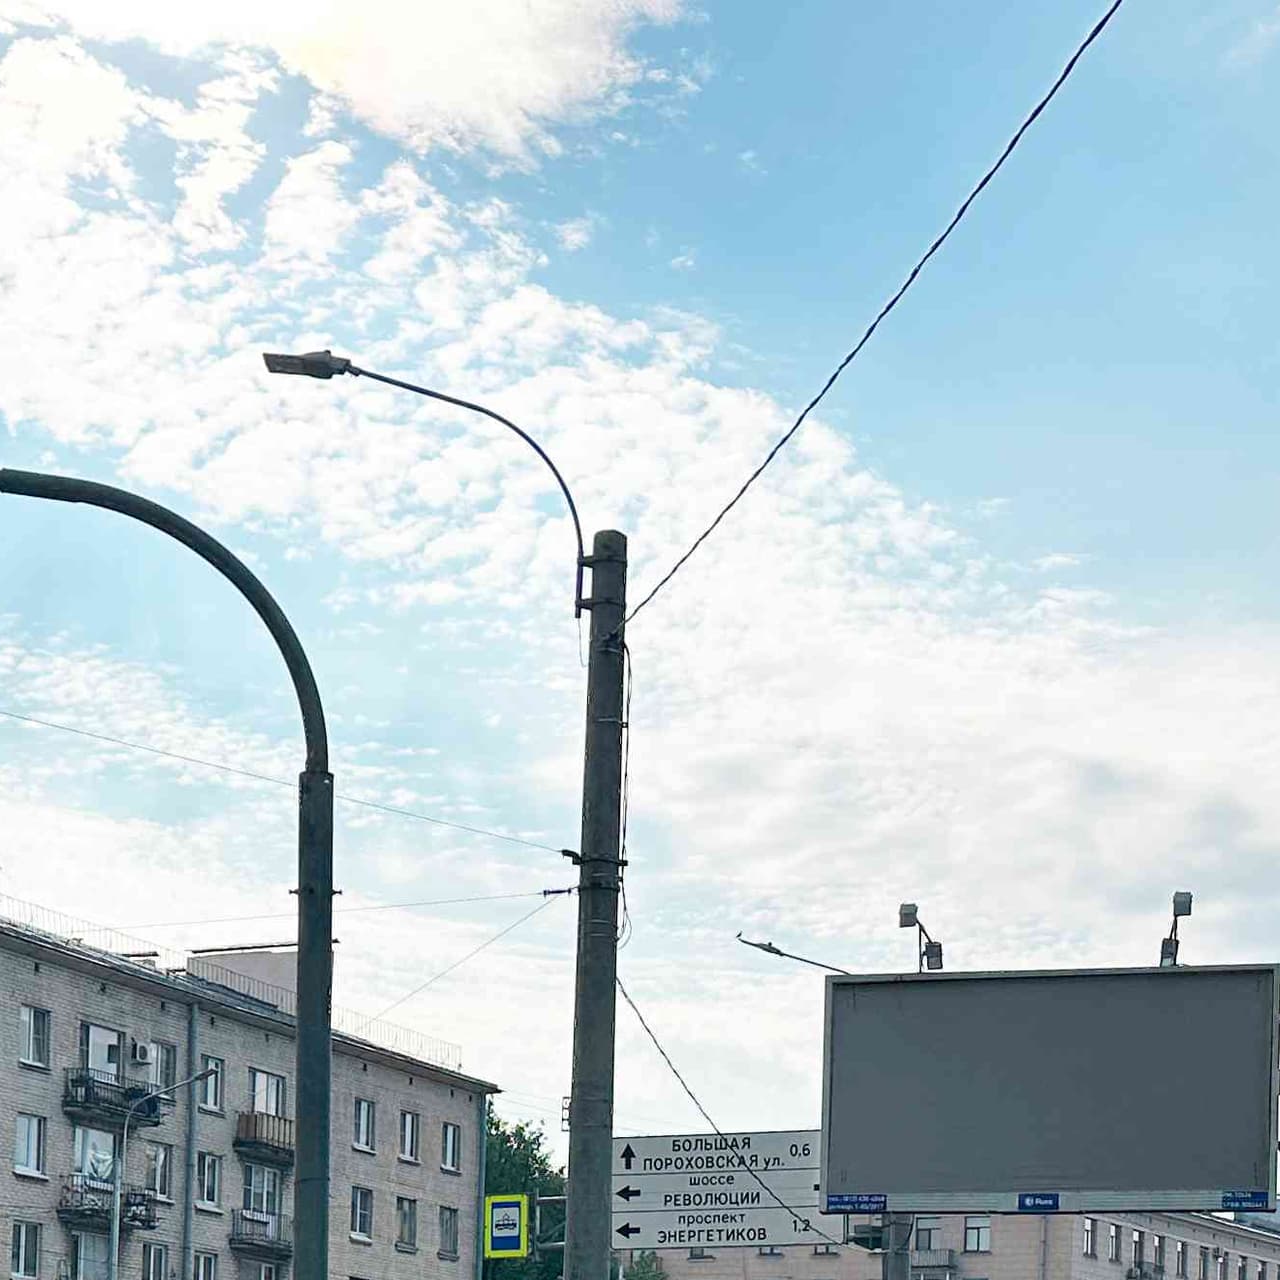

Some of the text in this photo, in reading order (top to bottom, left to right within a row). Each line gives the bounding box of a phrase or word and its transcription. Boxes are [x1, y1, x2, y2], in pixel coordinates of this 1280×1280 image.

[672, 1137, 751, 1152] БОЛЬШАЯ
[789, 1144, 811, 1158] 0,6
[643, 1155, 785, 1171] ПОРОХОВСКАЯ ул.
[689, 1174, 735, 1186] шоссе
[664, 1192, 761, 1207] РЕВОЛЮЦИИ
[678, 1213, 746, 1228] проспект
[792, 1219, 811, 1234] 1,2
[657, 1228, 767, 1244] ЭНЕРГЕТИКОВ
